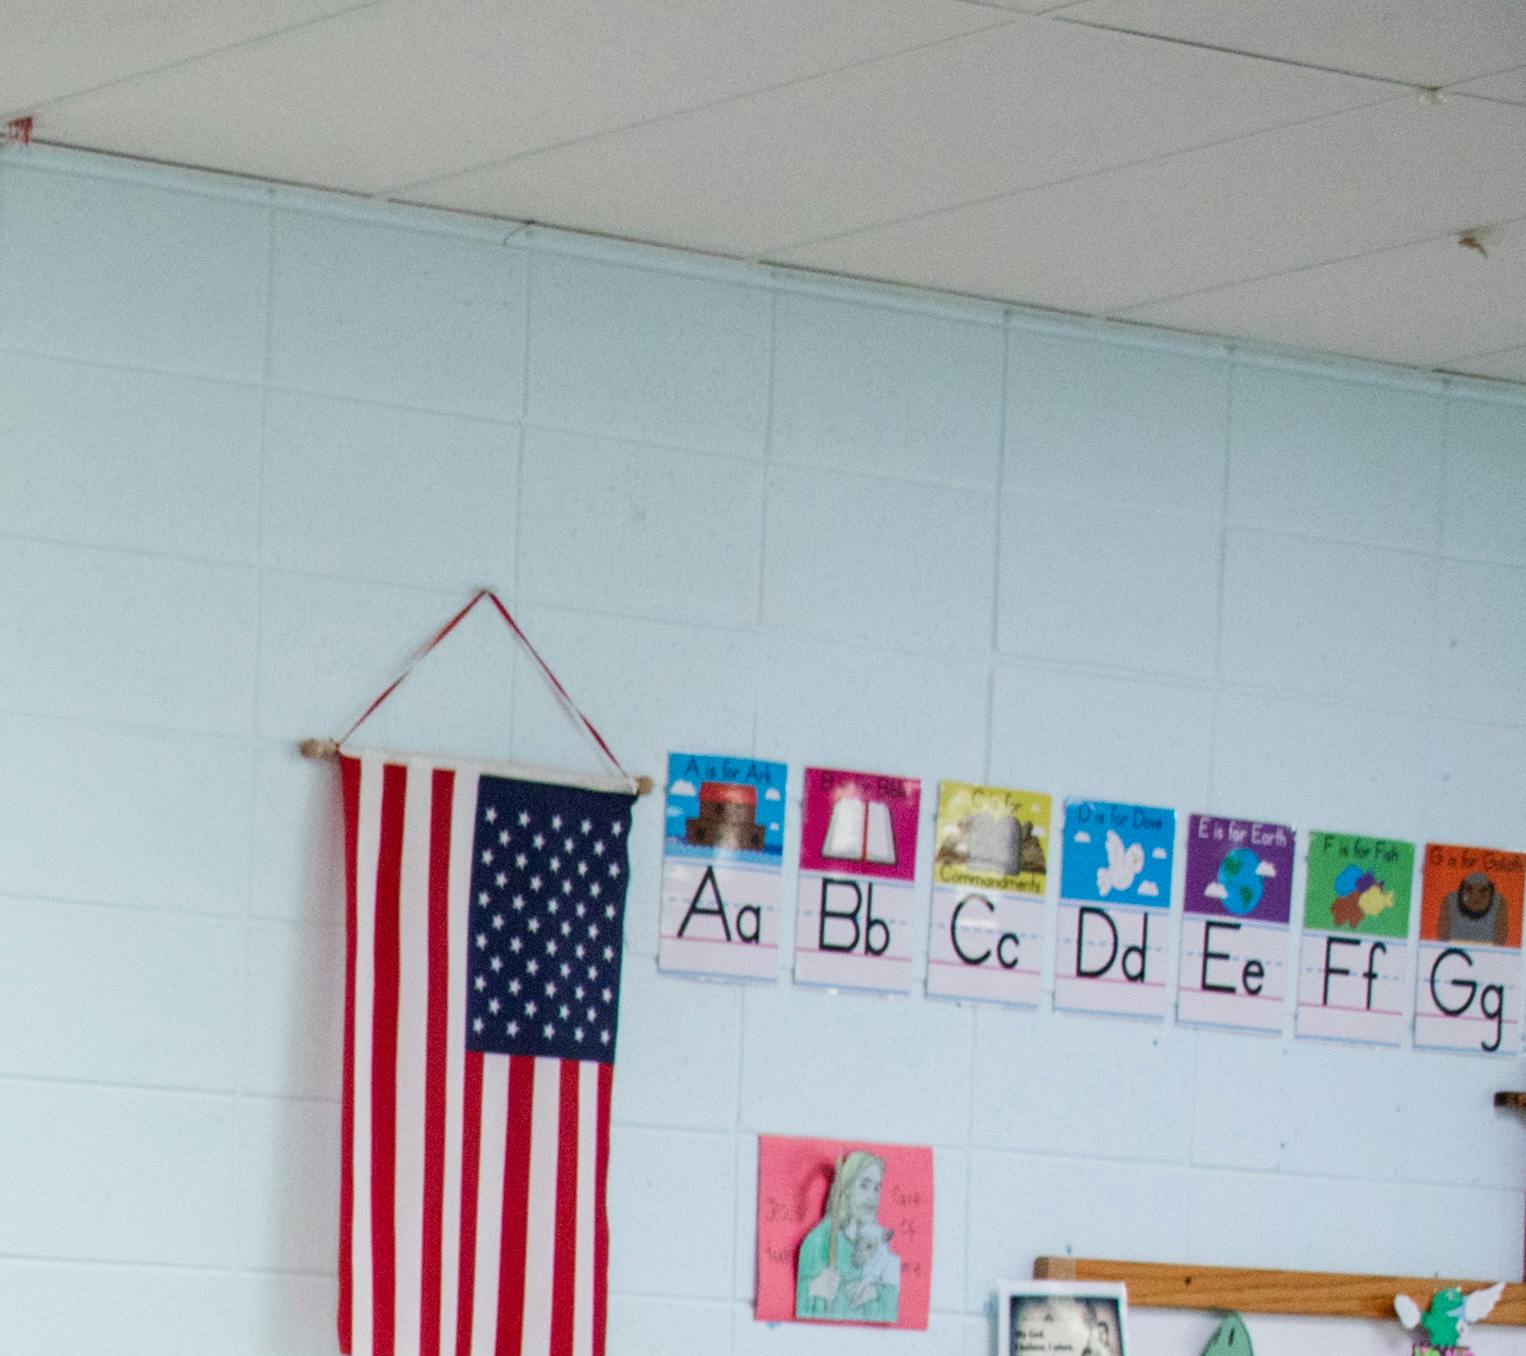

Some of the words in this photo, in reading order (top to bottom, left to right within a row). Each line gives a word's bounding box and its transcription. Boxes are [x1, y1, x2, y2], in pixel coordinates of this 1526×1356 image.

[1198, 819, 1210, 838] E
[1229, 823, 1247, 845] for
[1251, 827, 1287, 849] Earth
[1323, 834, 1334, 852] F
[1373, 840, 1399, 863] Fish
[677, 865, 762, 945] Aa
[819, 878, 890, 956] Bb
[951, 893, 1020, 969] Cc
[1076, 907, 1148, 983] Dd
[1201, 921, 1265, 996] Ee
[1323, 937, 1387, 1010] Ff
[1430, 947, 1505, 1052] Gg
